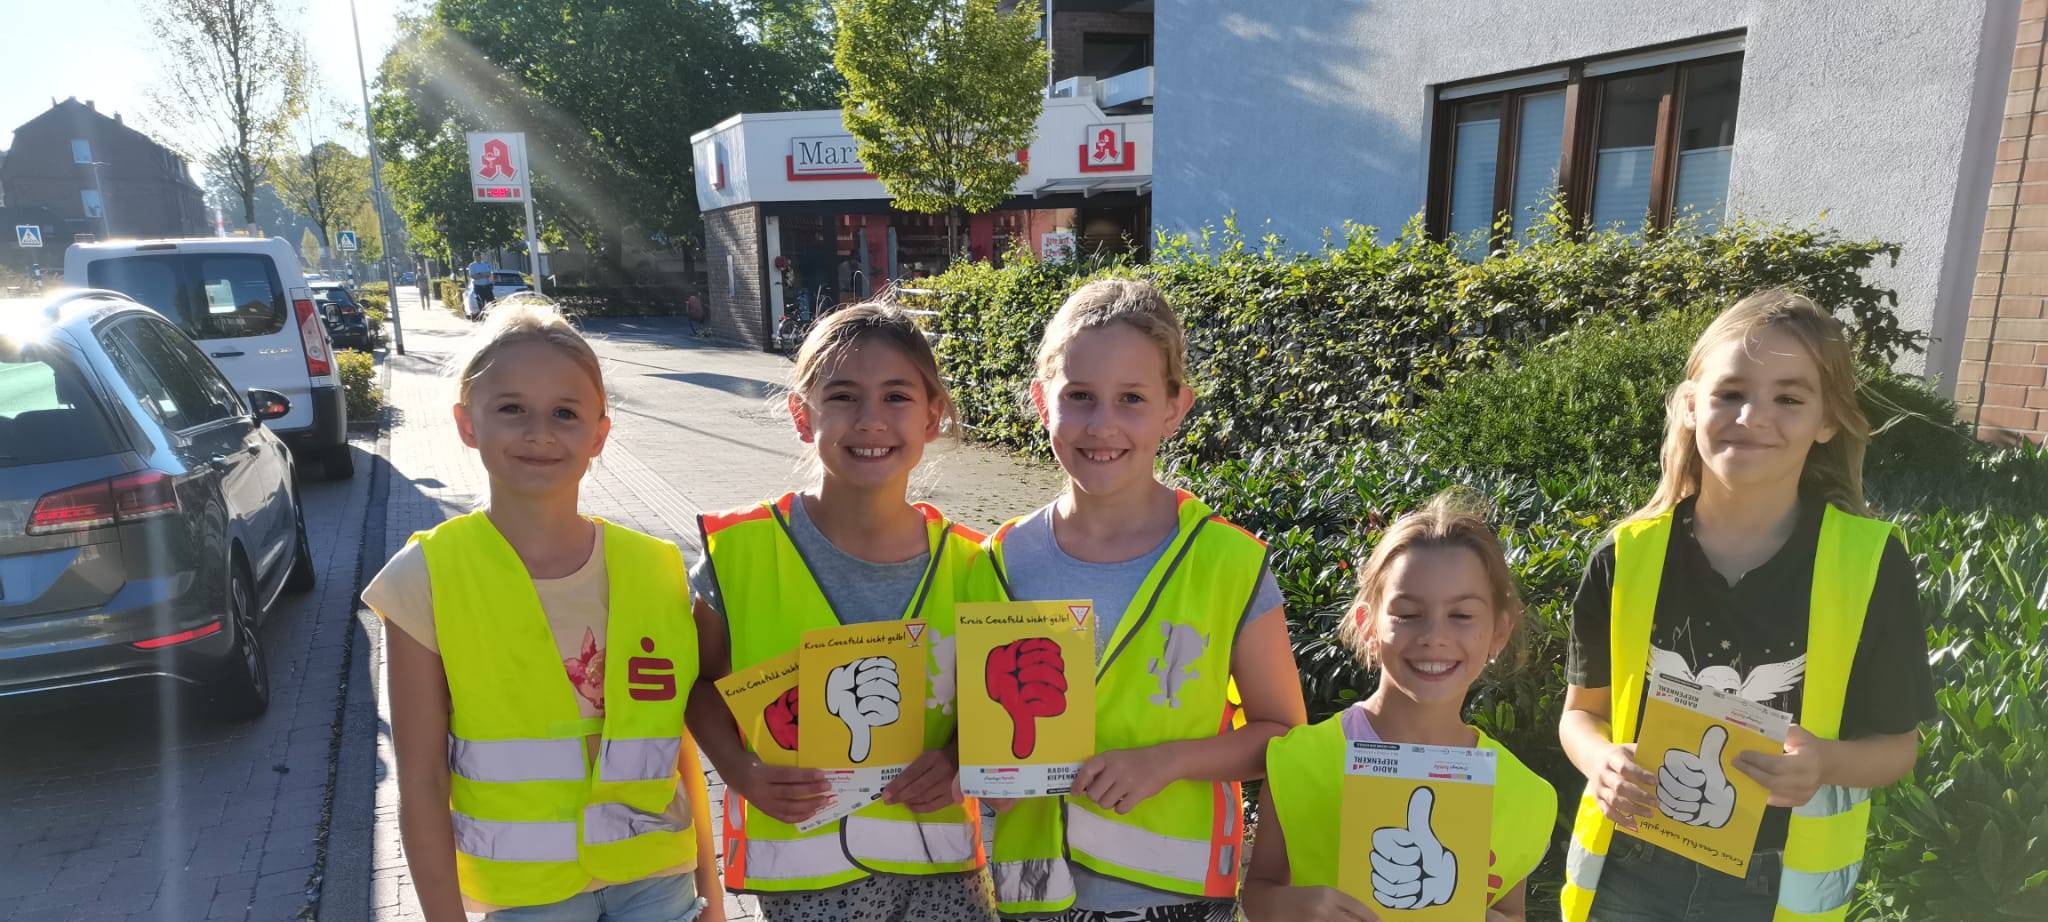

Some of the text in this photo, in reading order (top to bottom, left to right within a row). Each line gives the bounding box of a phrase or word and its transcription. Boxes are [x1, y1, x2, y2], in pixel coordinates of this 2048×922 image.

[960, 615, 983, 625] Kreis
[985, 614, 1025, 625] Coesfeld
[1049, 612, 1070, 626] gelb!
[804, 641, 826, 650] Kreis
[827, 636, 864, 648] Coesfeld
[887, 631, 906, 644] gelb!
[1674, 697, 1699, 709] RADIO
[1353, 755, 1399, 766] KIEPENKERL
[881, 767, 902, 775] RADIO
[1372, 764, 1399, 774] RADIO
